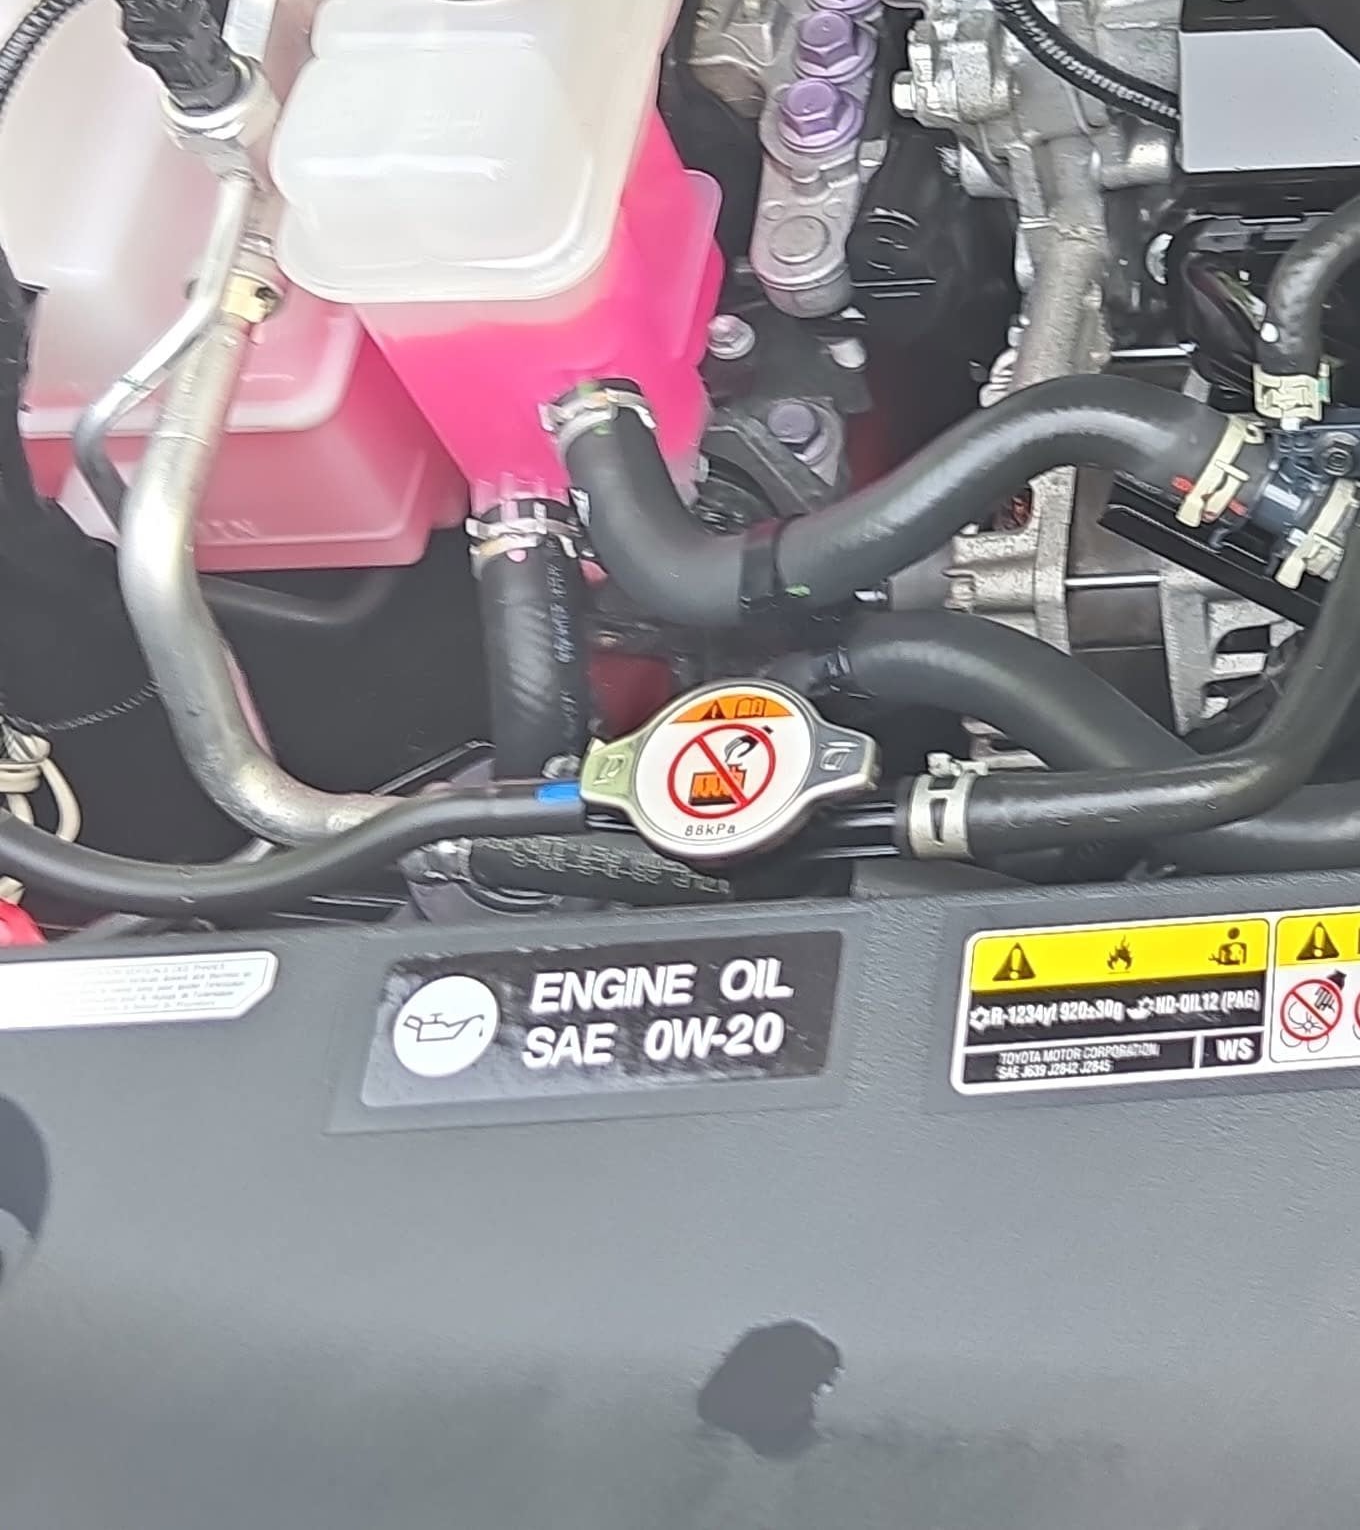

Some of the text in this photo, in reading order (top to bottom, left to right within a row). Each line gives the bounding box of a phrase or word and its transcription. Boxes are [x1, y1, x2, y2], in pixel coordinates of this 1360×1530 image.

[684, 823, 736, 837] 88kPa
[529, 957, 794, 1015] ENGINE OIL
[1221, 988, 1260, 1014] (PAG)
[521, 1011, 785, 1070] SAE 0W-20
[1214, 1037, 1256, 1063] WS
[999, 1042, 1161, 1067] TOYOTA MOTOR CORPORATION
[997, 1064, 1021, 1081] SAE
